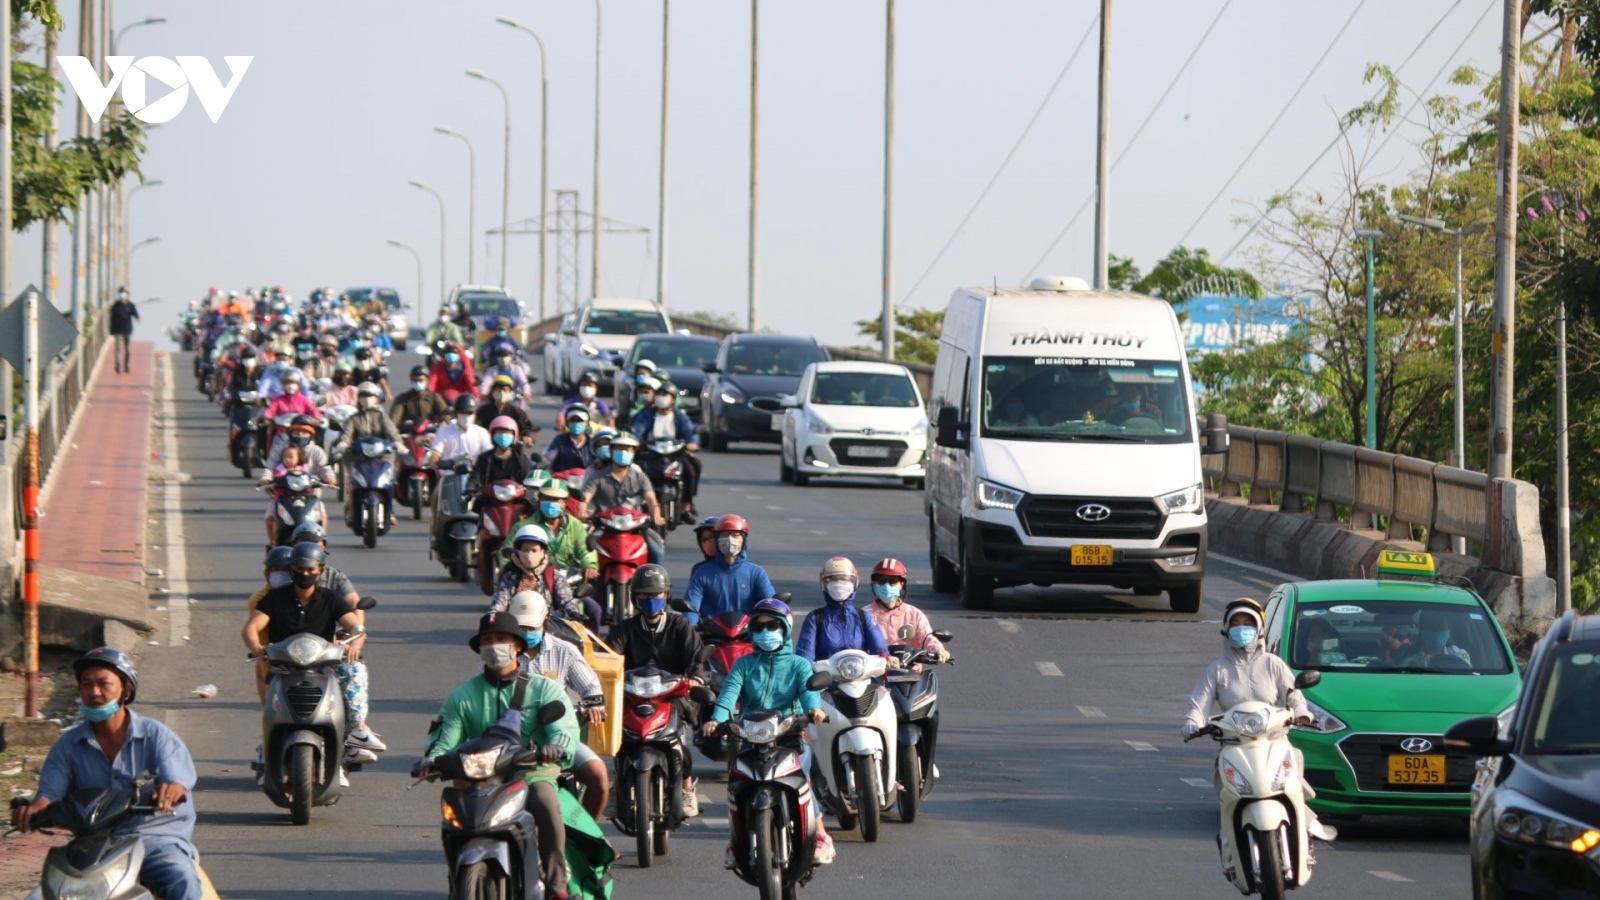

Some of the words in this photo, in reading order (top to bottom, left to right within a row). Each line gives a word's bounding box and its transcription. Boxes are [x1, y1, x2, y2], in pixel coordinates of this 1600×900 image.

[1010, 328, 1084, 346] THÀNH
[1075, 555, 1108, 564] 015.15
[1404, 757, 1429, 769] 60A
[1394, 770, 1439, 783] 537.35
